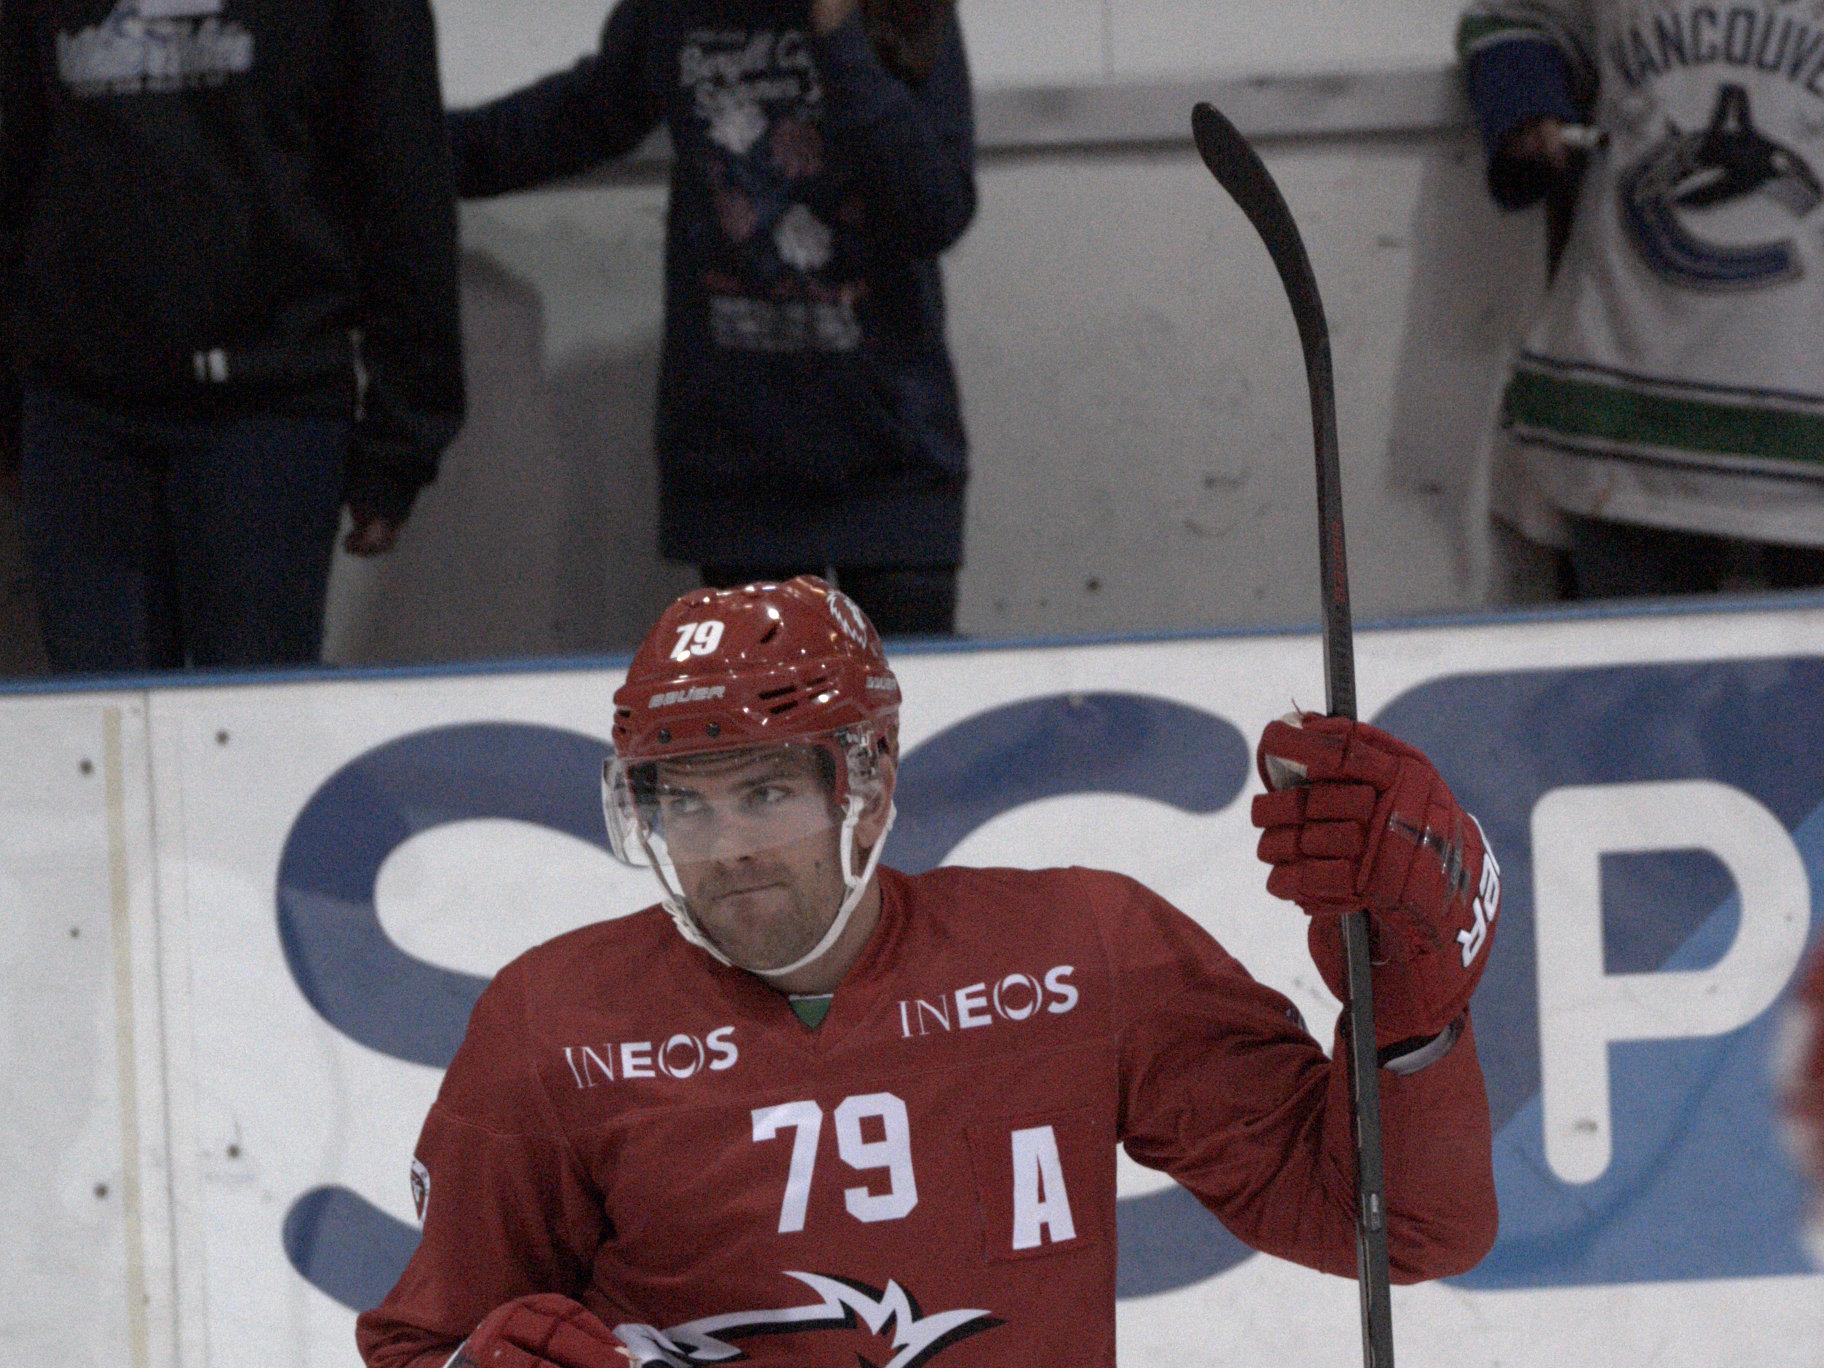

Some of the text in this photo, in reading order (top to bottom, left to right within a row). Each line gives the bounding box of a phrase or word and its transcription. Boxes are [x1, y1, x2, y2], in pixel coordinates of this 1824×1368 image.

[668, 620, 725, 662] 79
[1456, 812, 1501, 968] ER
[899, 965, 1079, 1038] INEOS
[564, 1026, 739, 1089] INEOS
[751, 1092, 919, 1234] 79
[1010, 1125, 1077, 1250] A
